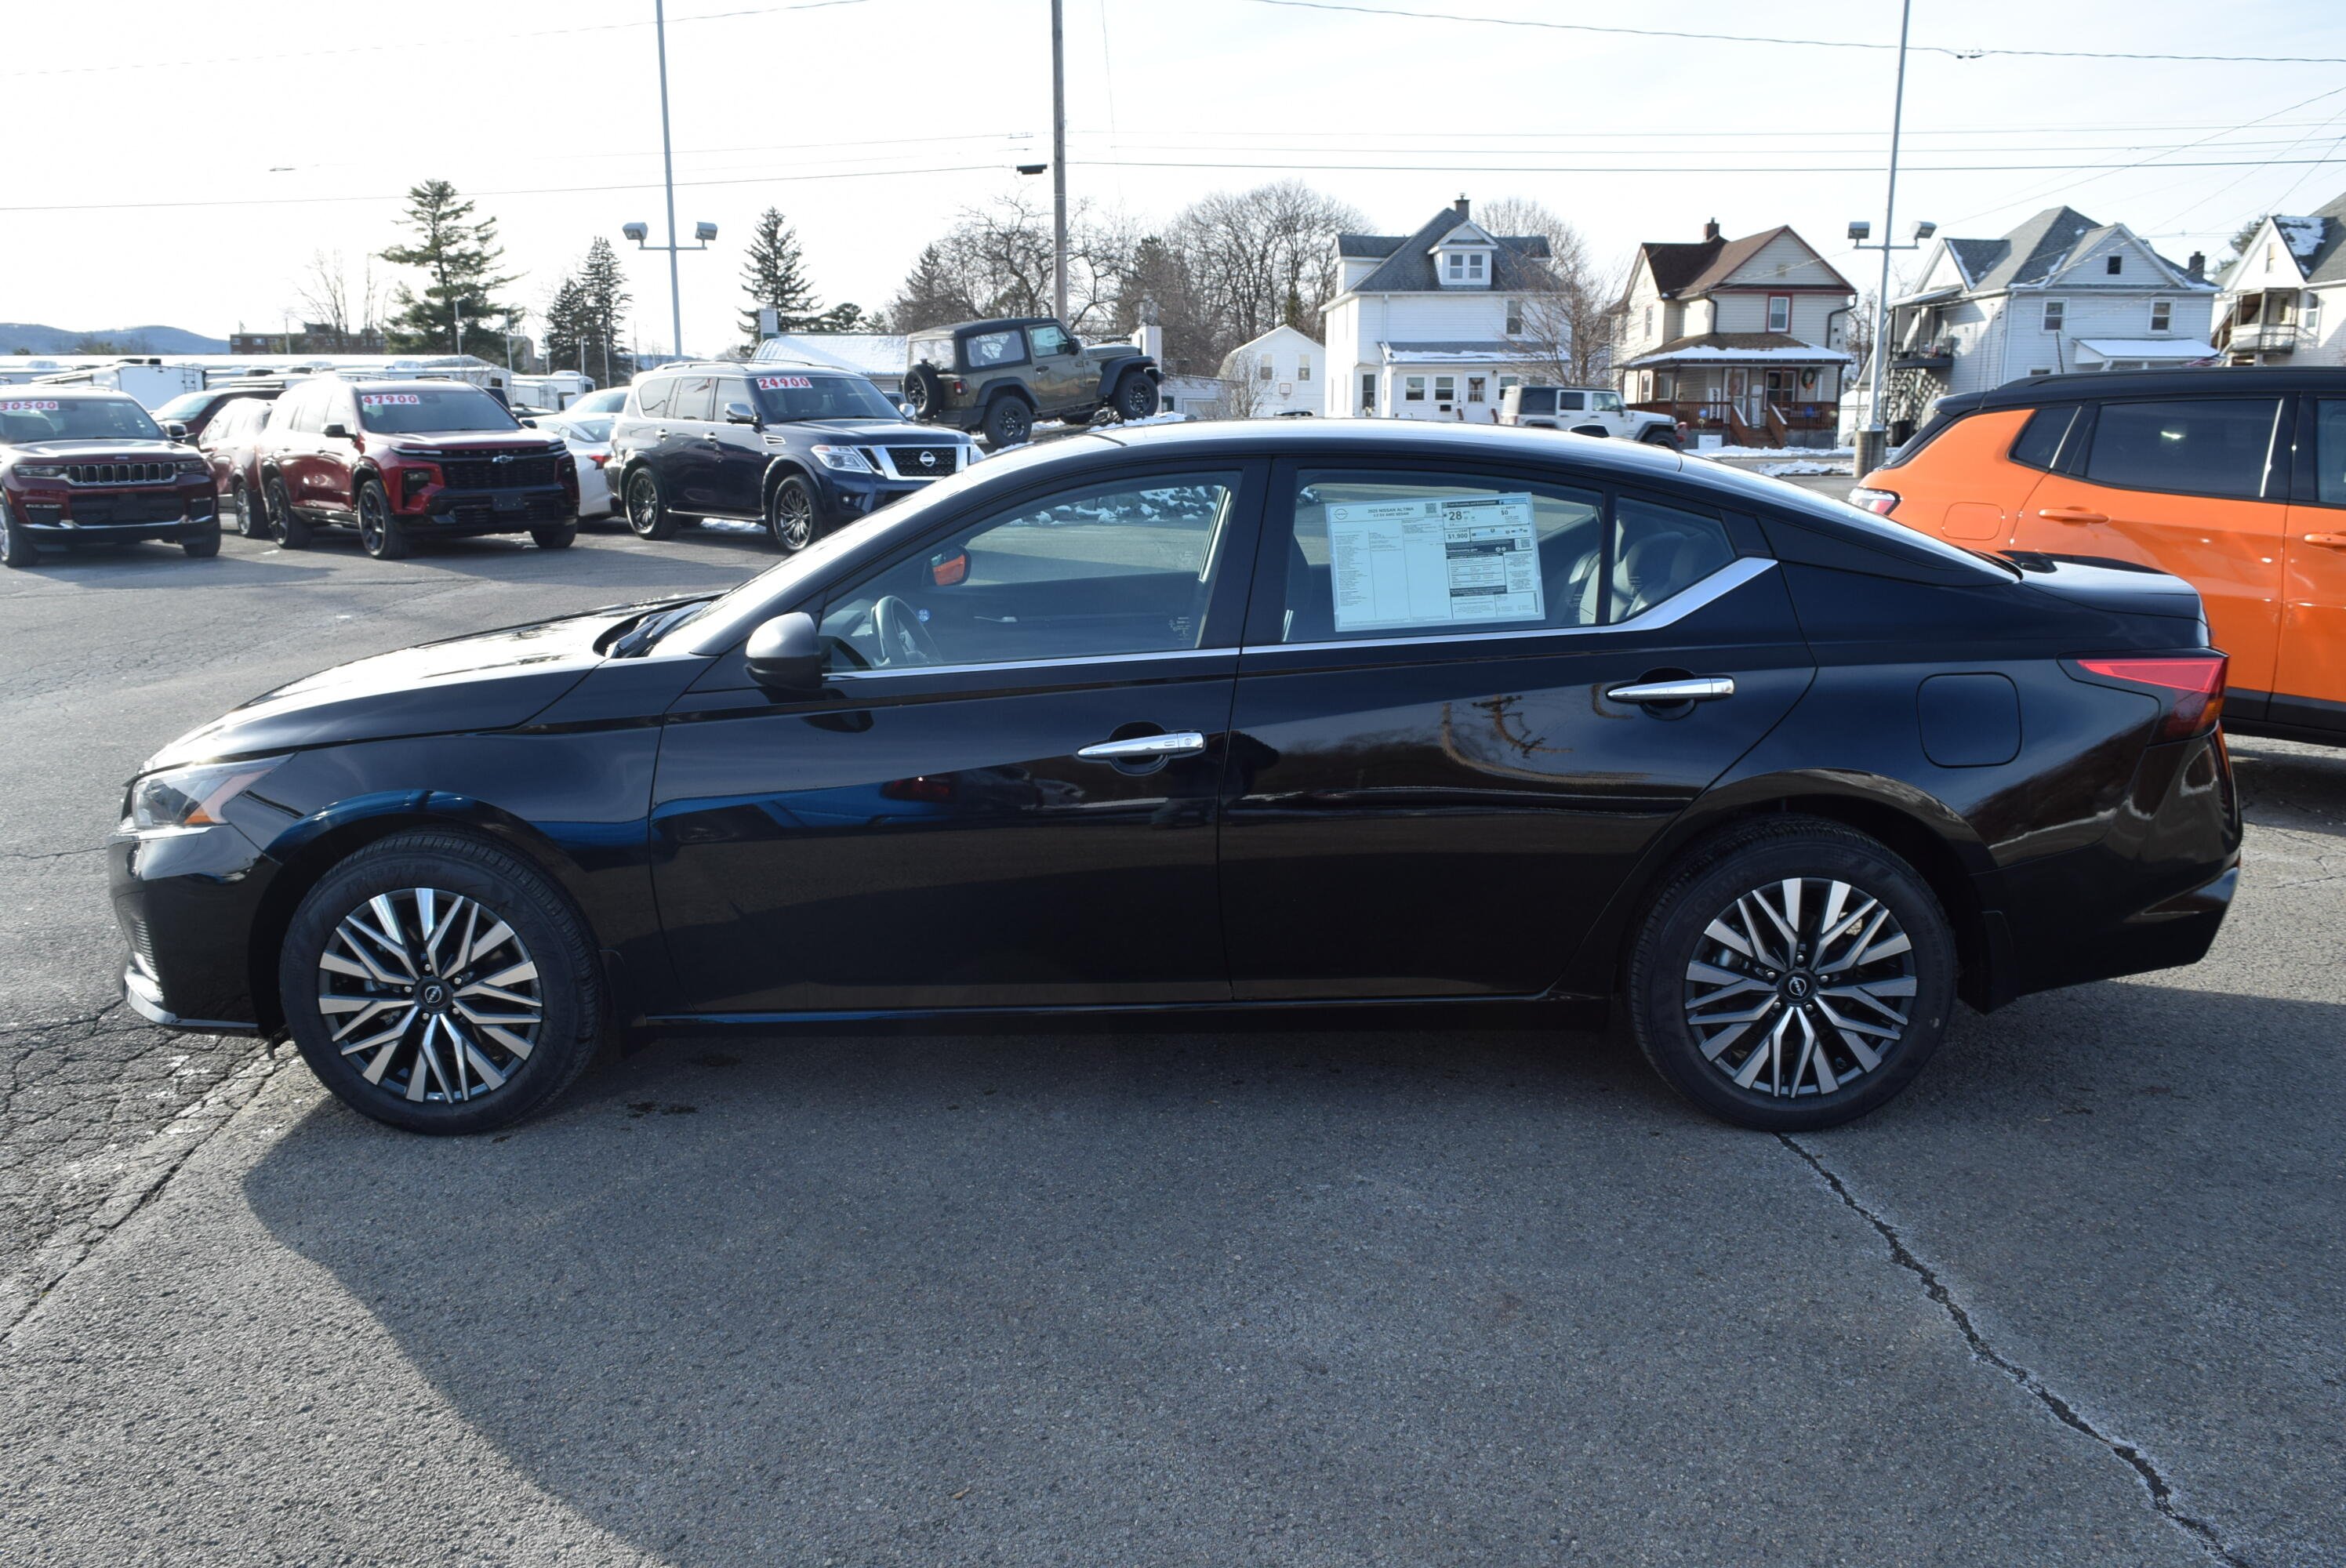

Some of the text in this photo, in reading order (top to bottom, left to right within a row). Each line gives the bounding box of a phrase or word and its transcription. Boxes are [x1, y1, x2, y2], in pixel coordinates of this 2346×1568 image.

[758, 378, 809, 389] 24900
[363, 394, 417, 405] 47900
[0, 401, 56, 411] 30500
[1448, 511, 1462, 521] 28
